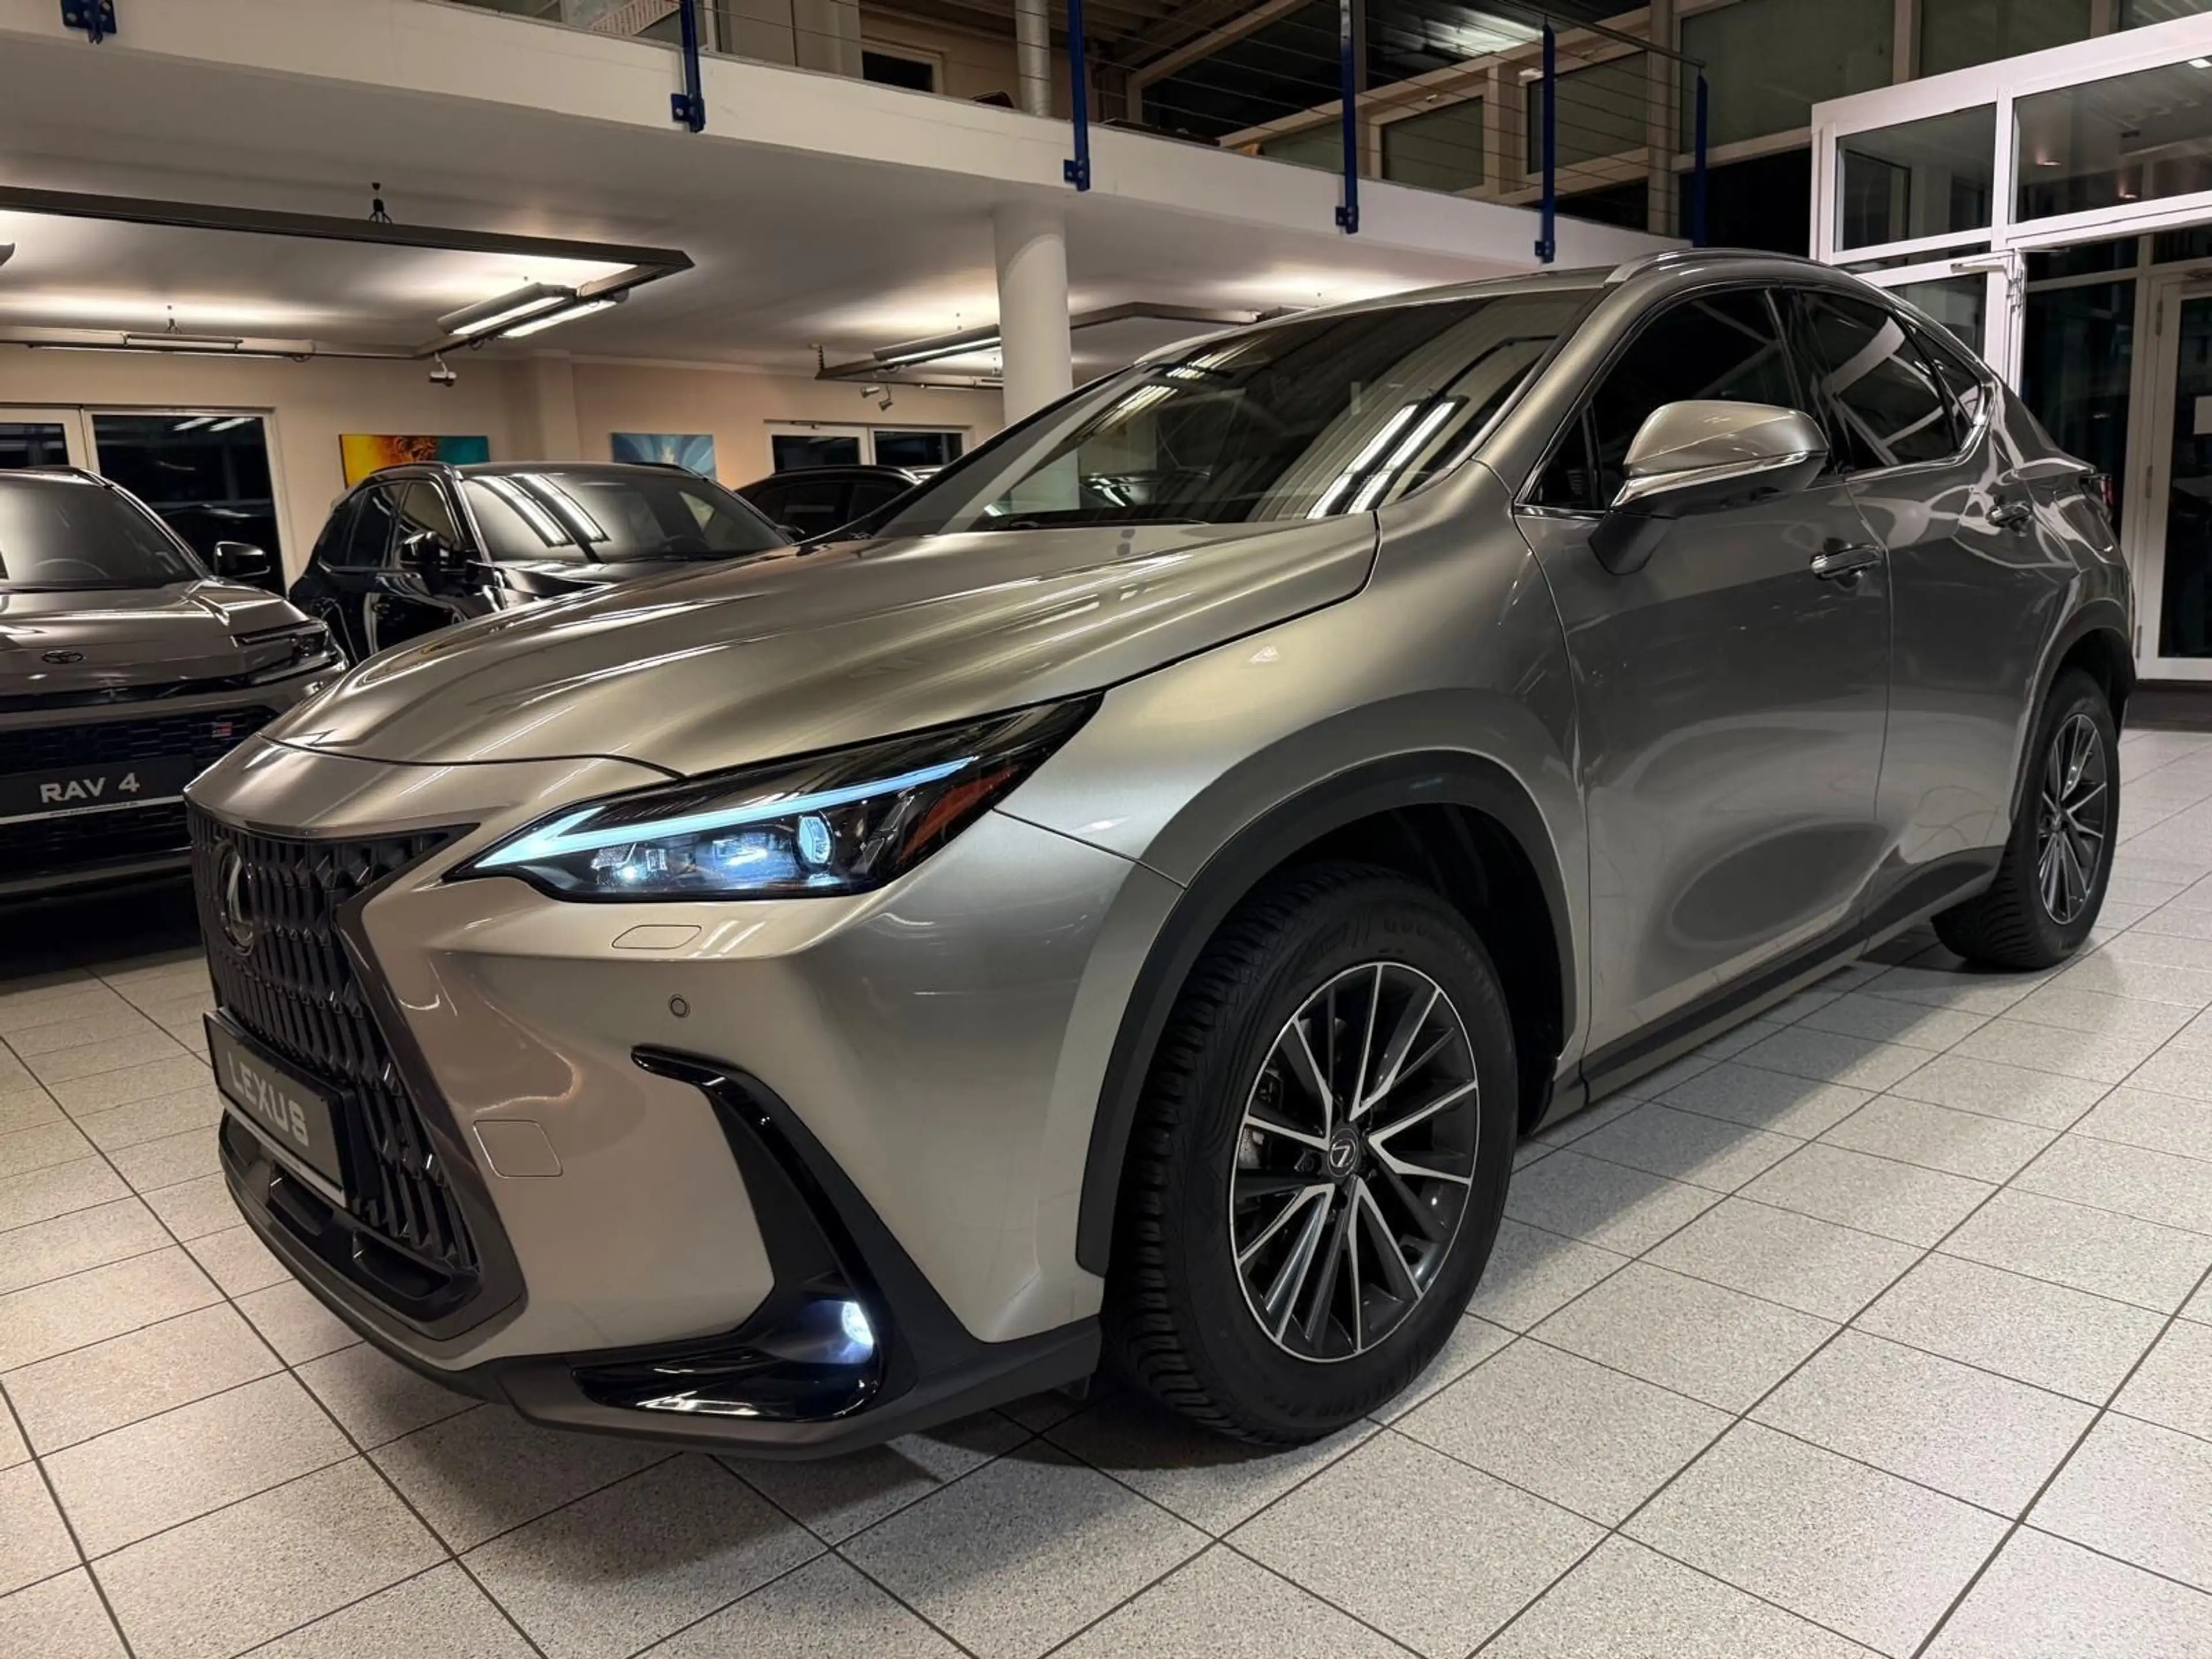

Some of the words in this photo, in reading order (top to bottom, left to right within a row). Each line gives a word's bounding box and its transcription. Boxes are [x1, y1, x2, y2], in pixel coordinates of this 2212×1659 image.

[40, 777, 106, 804] RAV
[118, 772, 141, 793] 4
[228, 1050, 309, 1147] LEXUS
